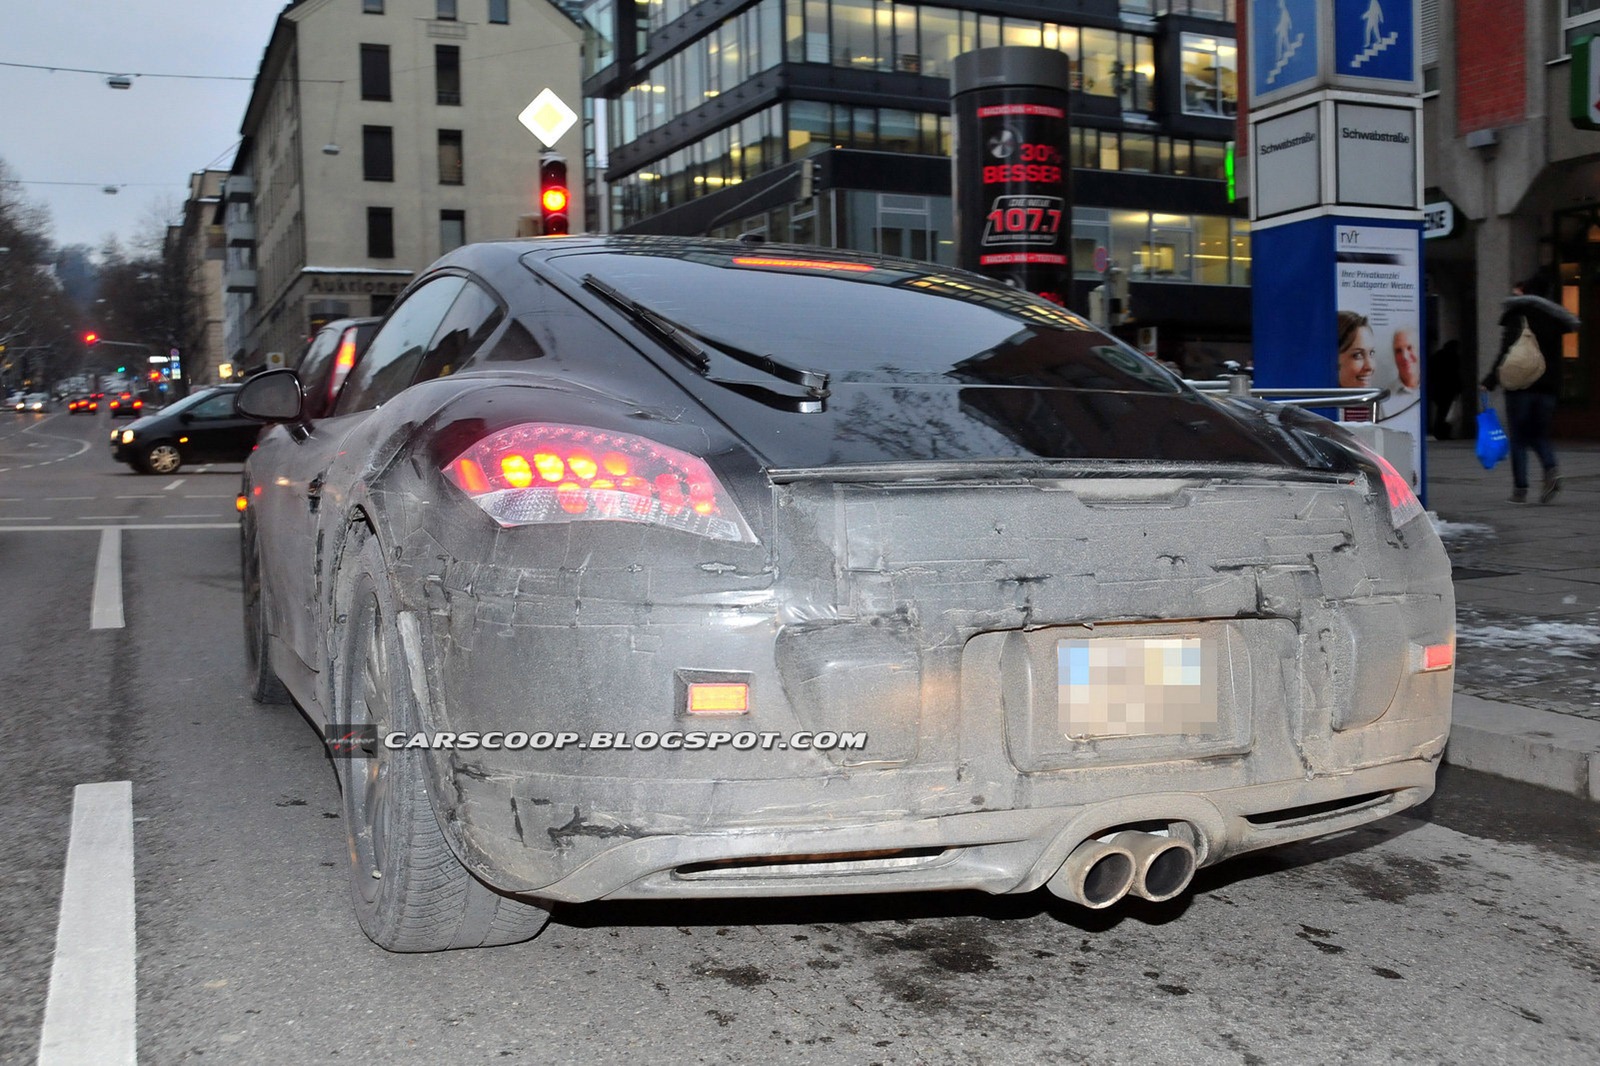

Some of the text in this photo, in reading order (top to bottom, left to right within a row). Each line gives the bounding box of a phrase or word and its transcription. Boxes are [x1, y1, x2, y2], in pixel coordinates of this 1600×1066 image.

[1260, 132, 1315, 155] Schwabstraße
[1342, 128, 1409, 144] Schwabstraße
[983, 164, 1061, 184] BESSER
[986, 208, 1062, 233] 107.7
[1357, 271, 1400, 280] Privatkanzlei
[1352, 280, 1389, 290] Stuttgarter
